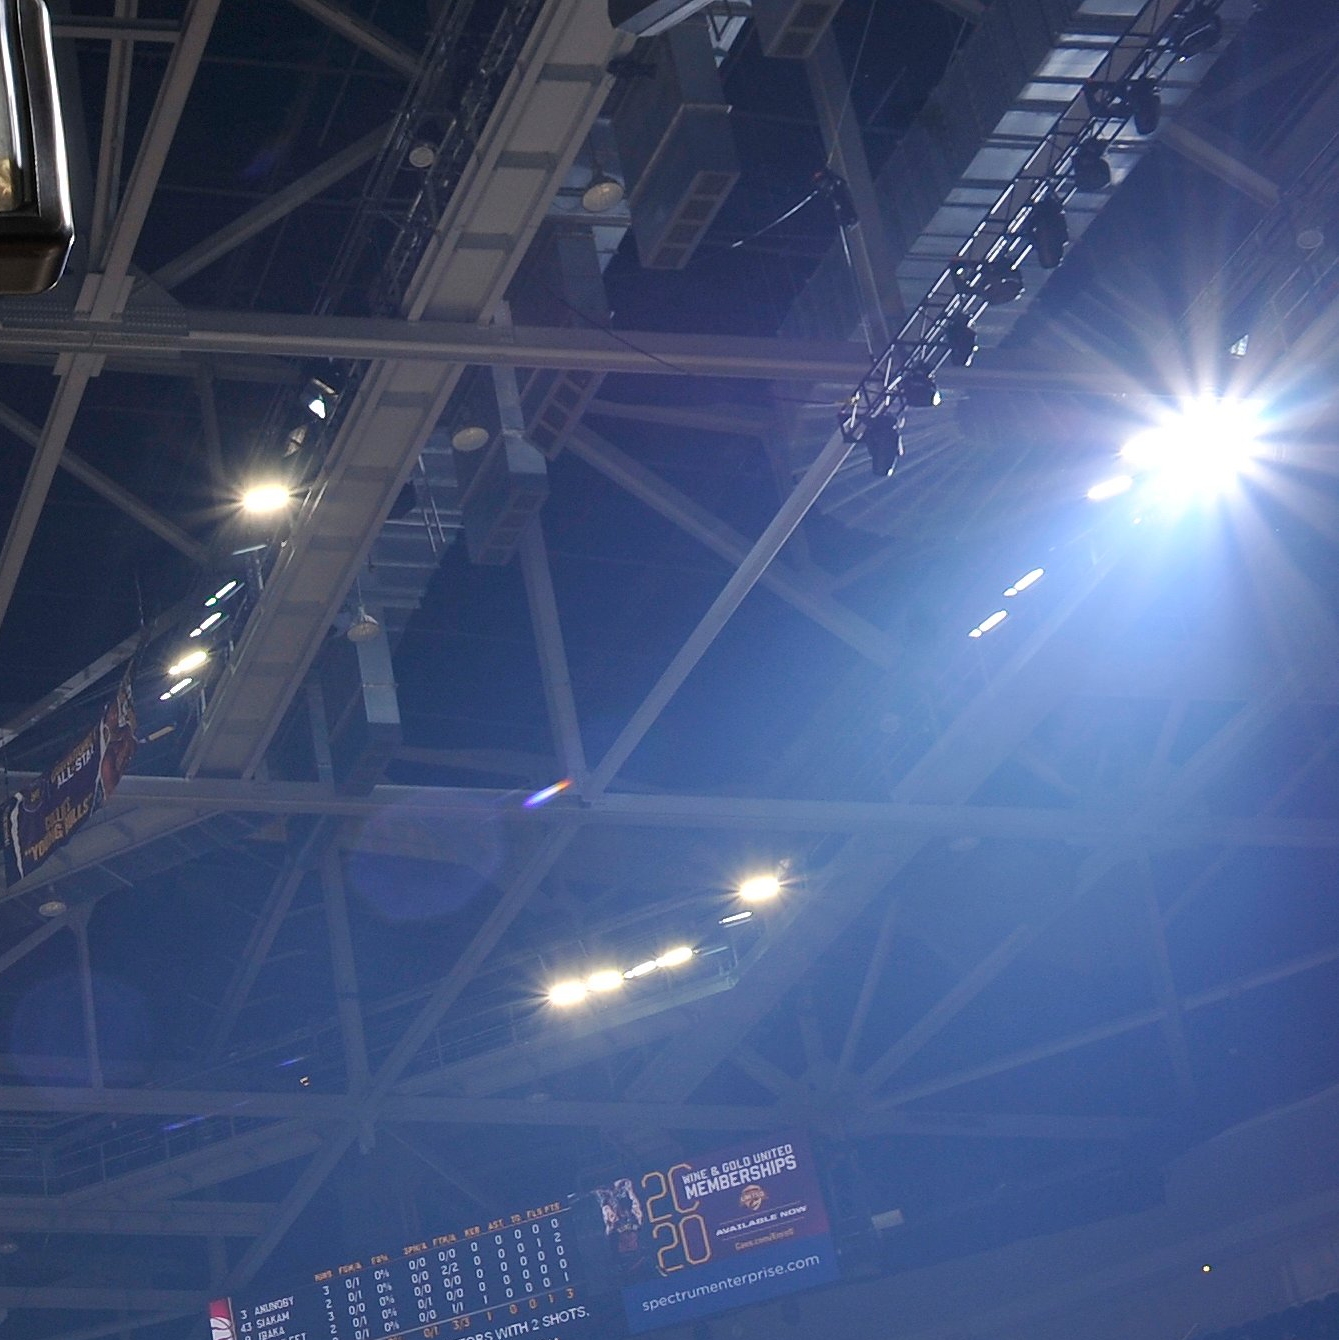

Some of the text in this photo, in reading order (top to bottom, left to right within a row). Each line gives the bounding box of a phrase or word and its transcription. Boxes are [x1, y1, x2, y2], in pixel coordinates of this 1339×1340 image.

[722, 1156, 752, 1174] GOLD
[754, 1143, 793, 1164] UNITED
[684, 1154, 798, 1200] MEMBERSHIPS
[716, 1205, 808, 1237] AVAILABLE NOW
[642, 1254, 820, 1312] spectrumenterprise.com
[256, 1311, 290, 1329] SIAKAM
[494, 1321, 529, 1340] WITH
[531, 1318, 541, 1331] 2
[541, 1305, 590, 1328] SHOTS.
